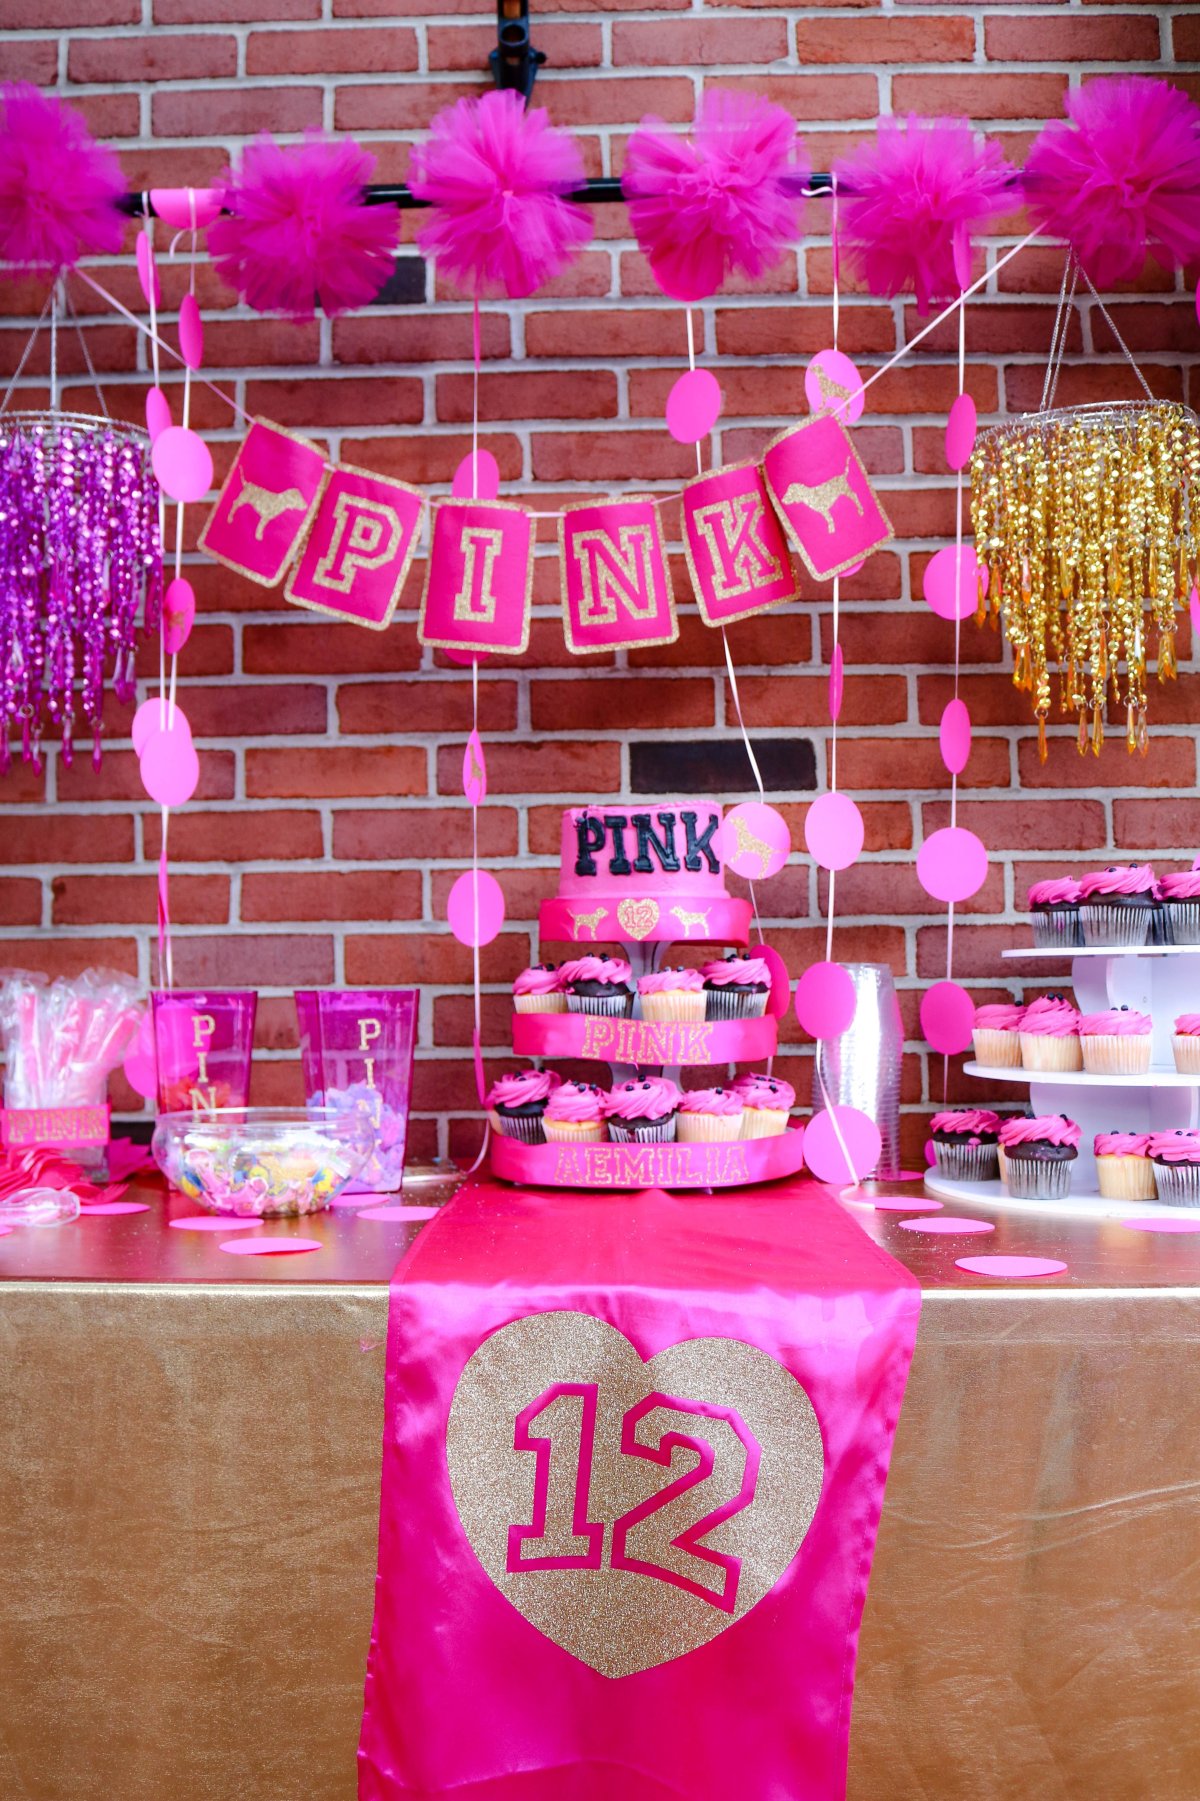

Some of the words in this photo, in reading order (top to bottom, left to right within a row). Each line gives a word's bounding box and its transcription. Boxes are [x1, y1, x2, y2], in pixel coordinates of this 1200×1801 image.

[313, 492, 784, 625] PINK
[575, 811, 720, 876] PINK
[624, 905, 654, 928] 12
[581, 1015, 714, 1064] PINK
[8, 1109, 106, 1143] PINK
[554, 1145, 749, 1186] AEMILIA
[506, 1382, 762, 1614] 12
